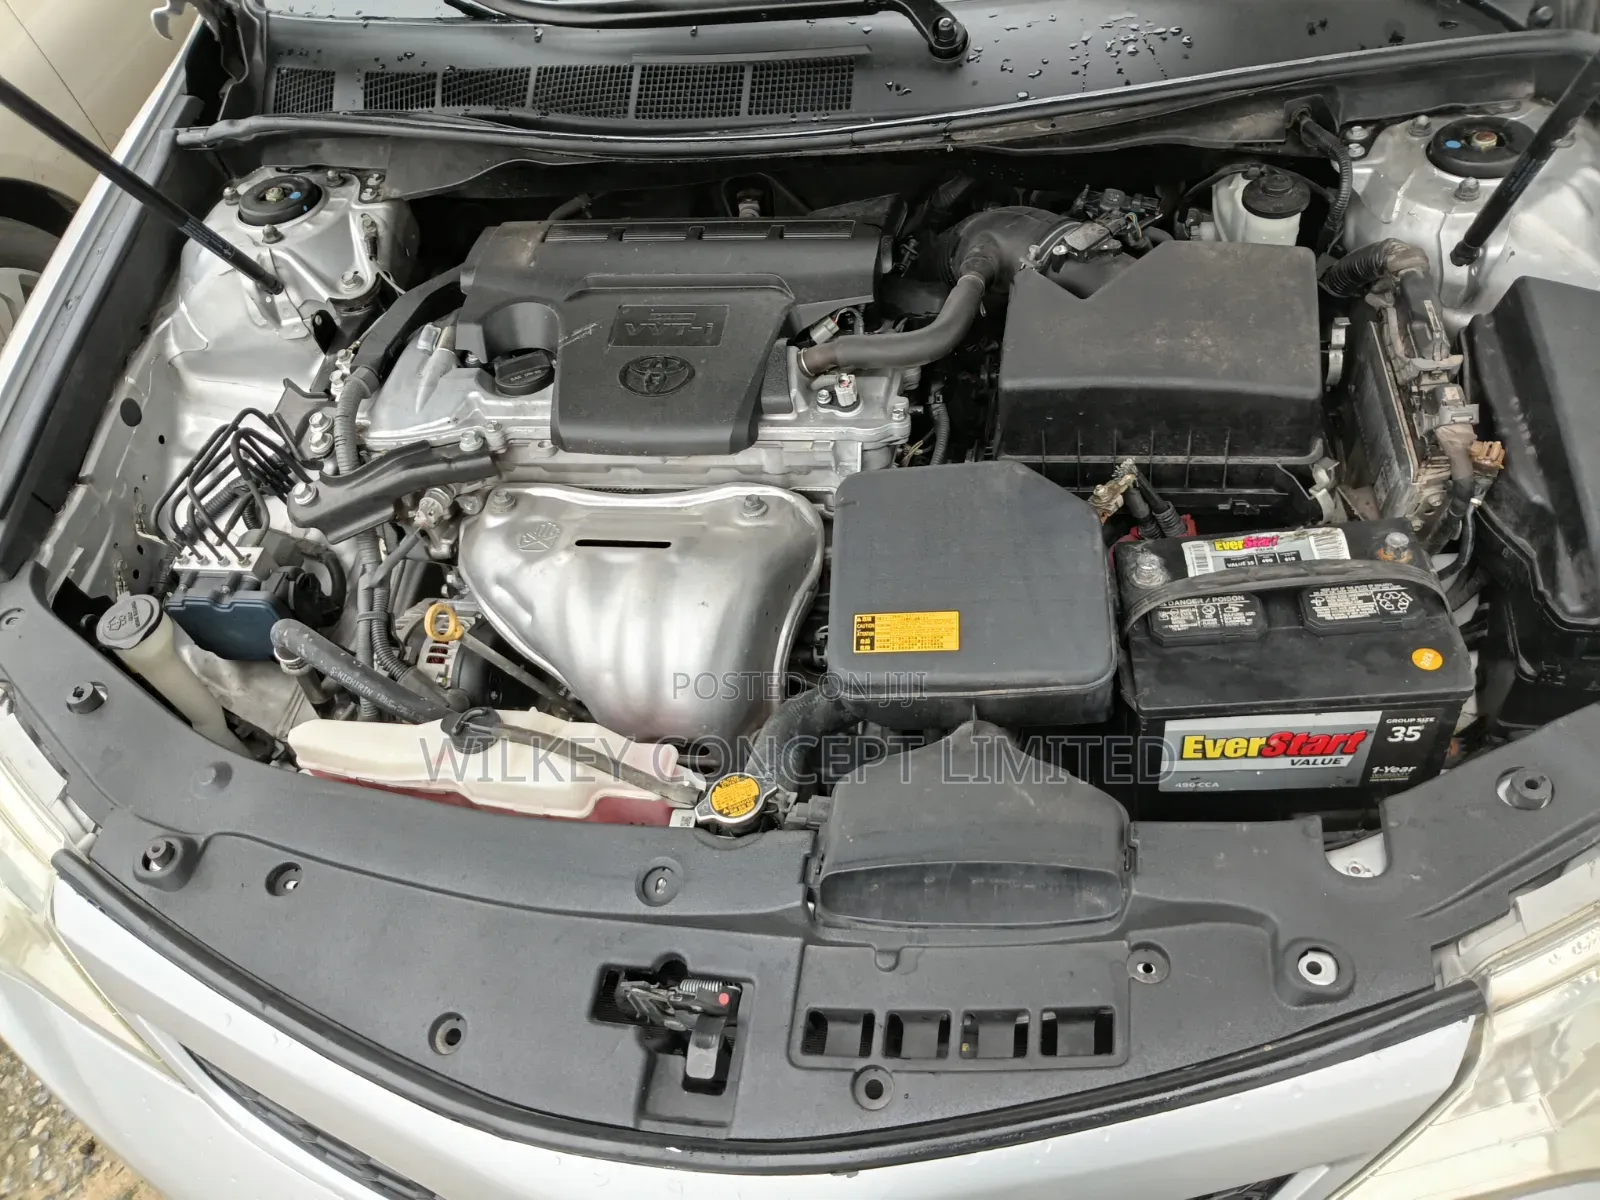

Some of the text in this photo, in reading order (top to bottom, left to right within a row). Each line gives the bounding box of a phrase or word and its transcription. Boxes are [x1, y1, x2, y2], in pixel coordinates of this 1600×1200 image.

[624, 322, 714, 336] VVT-i
[1214, 535, 1280, 551] EverStart
[1168, 598, 1204, 606] DANGER
[1212, 595, 1245, 603] POISON
[1386, 724, 1425, 743] 35
[1180, 729, 1368, 761] EverStart
[1290, 757, 1345, 768] VALUE
[1372, 765, 1418, 774] 1-Year
[1174, 781, 1195, 789] 490
